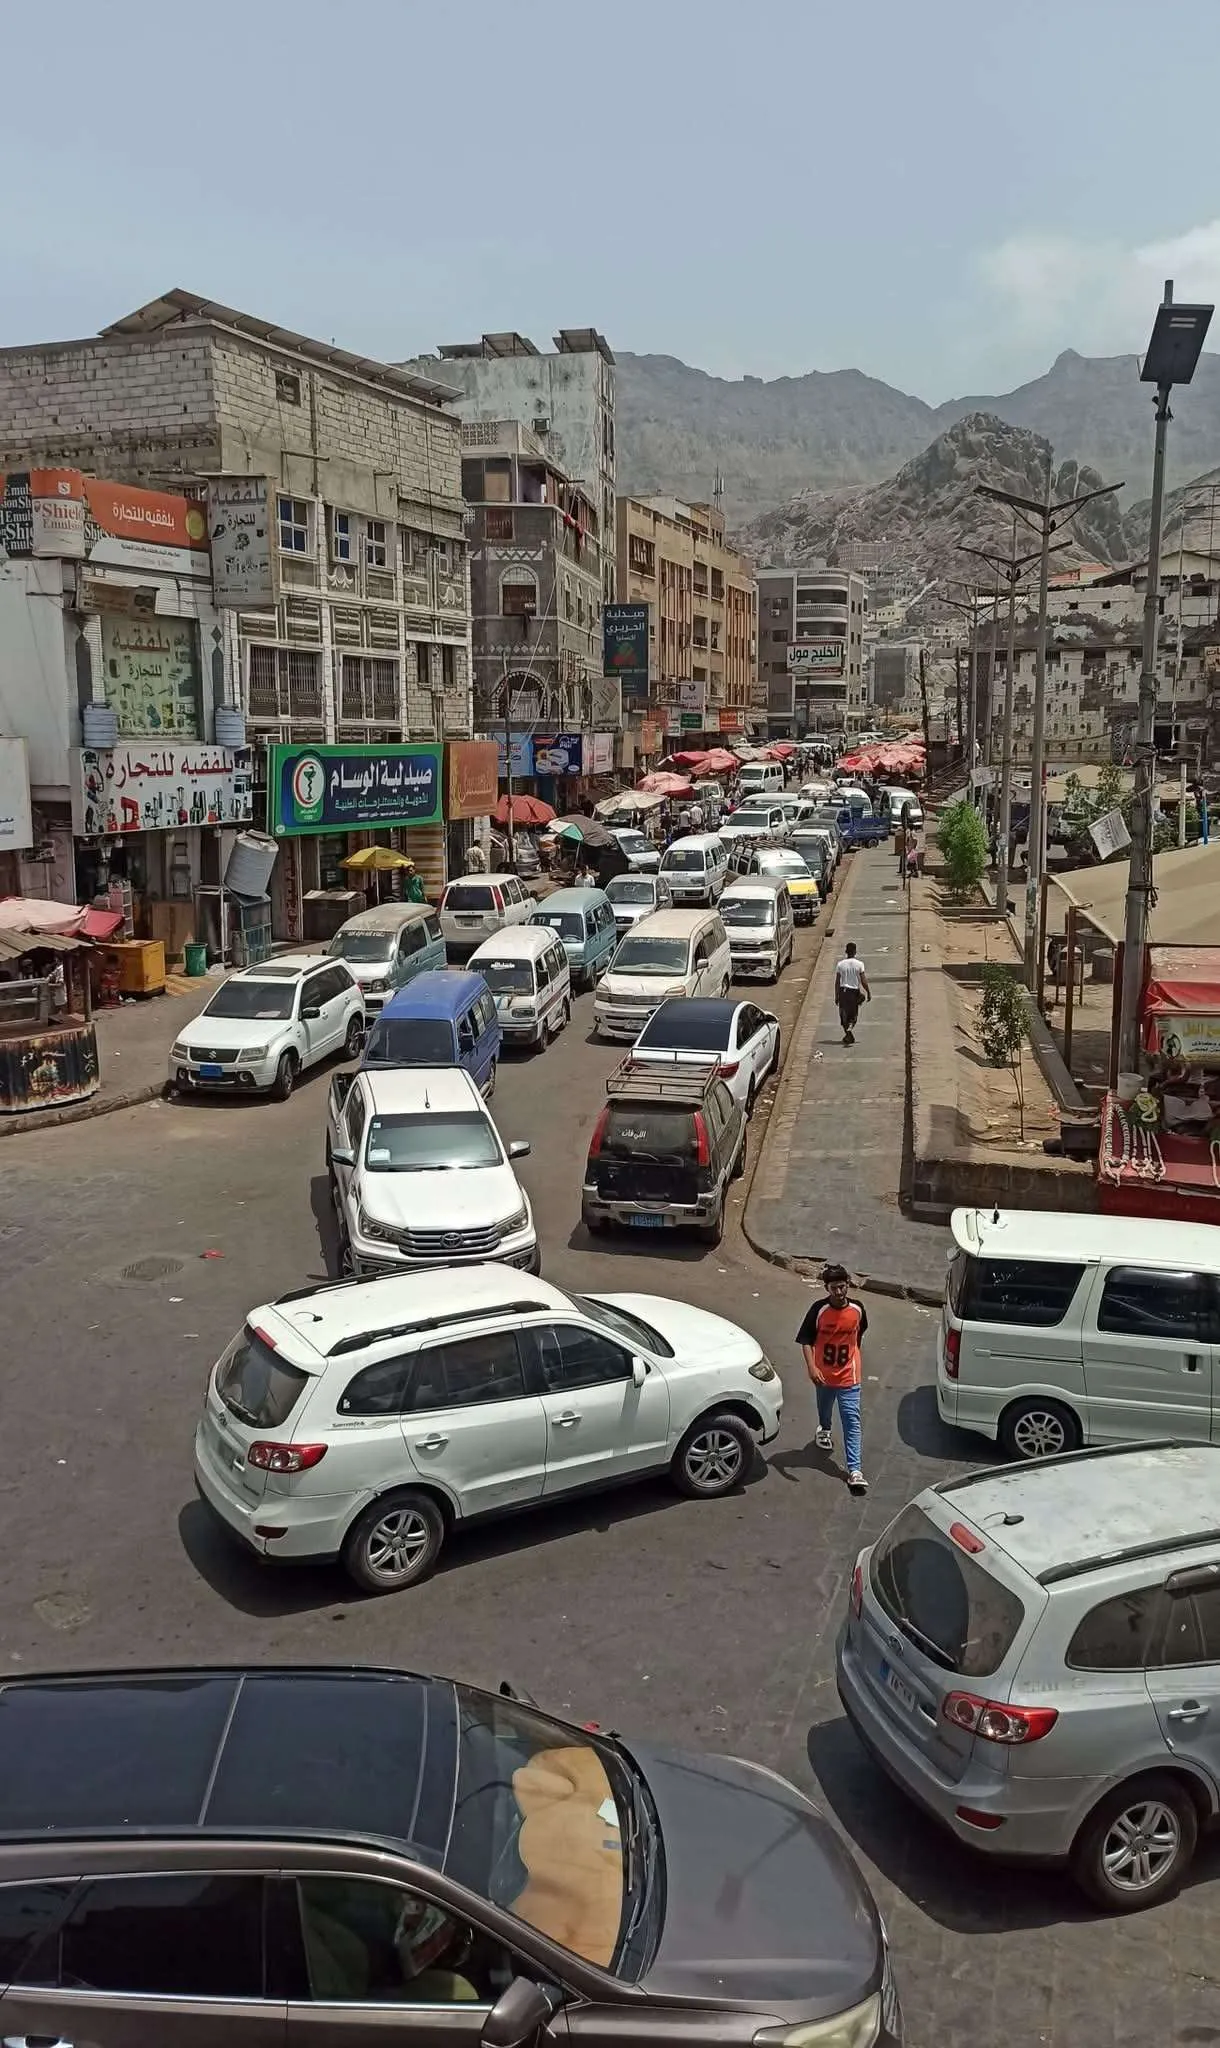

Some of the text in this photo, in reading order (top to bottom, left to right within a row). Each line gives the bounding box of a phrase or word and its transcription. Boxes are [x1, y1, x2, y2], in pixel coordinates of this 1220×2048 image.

[113, 501, 144, 523] للتجارة
[146, 508, 175, 530] بلفقيه
[227, 513, 256, 531] للتجارة
[789, 645, 840, 664] الخليج مول
[105, 751, 234, 787] بلفقيه للتجارة
[330, 762, 378, 797] الوسام
[381, 760, 432, 793] صيدلية
[824, 1343, 849, 1367] 98
